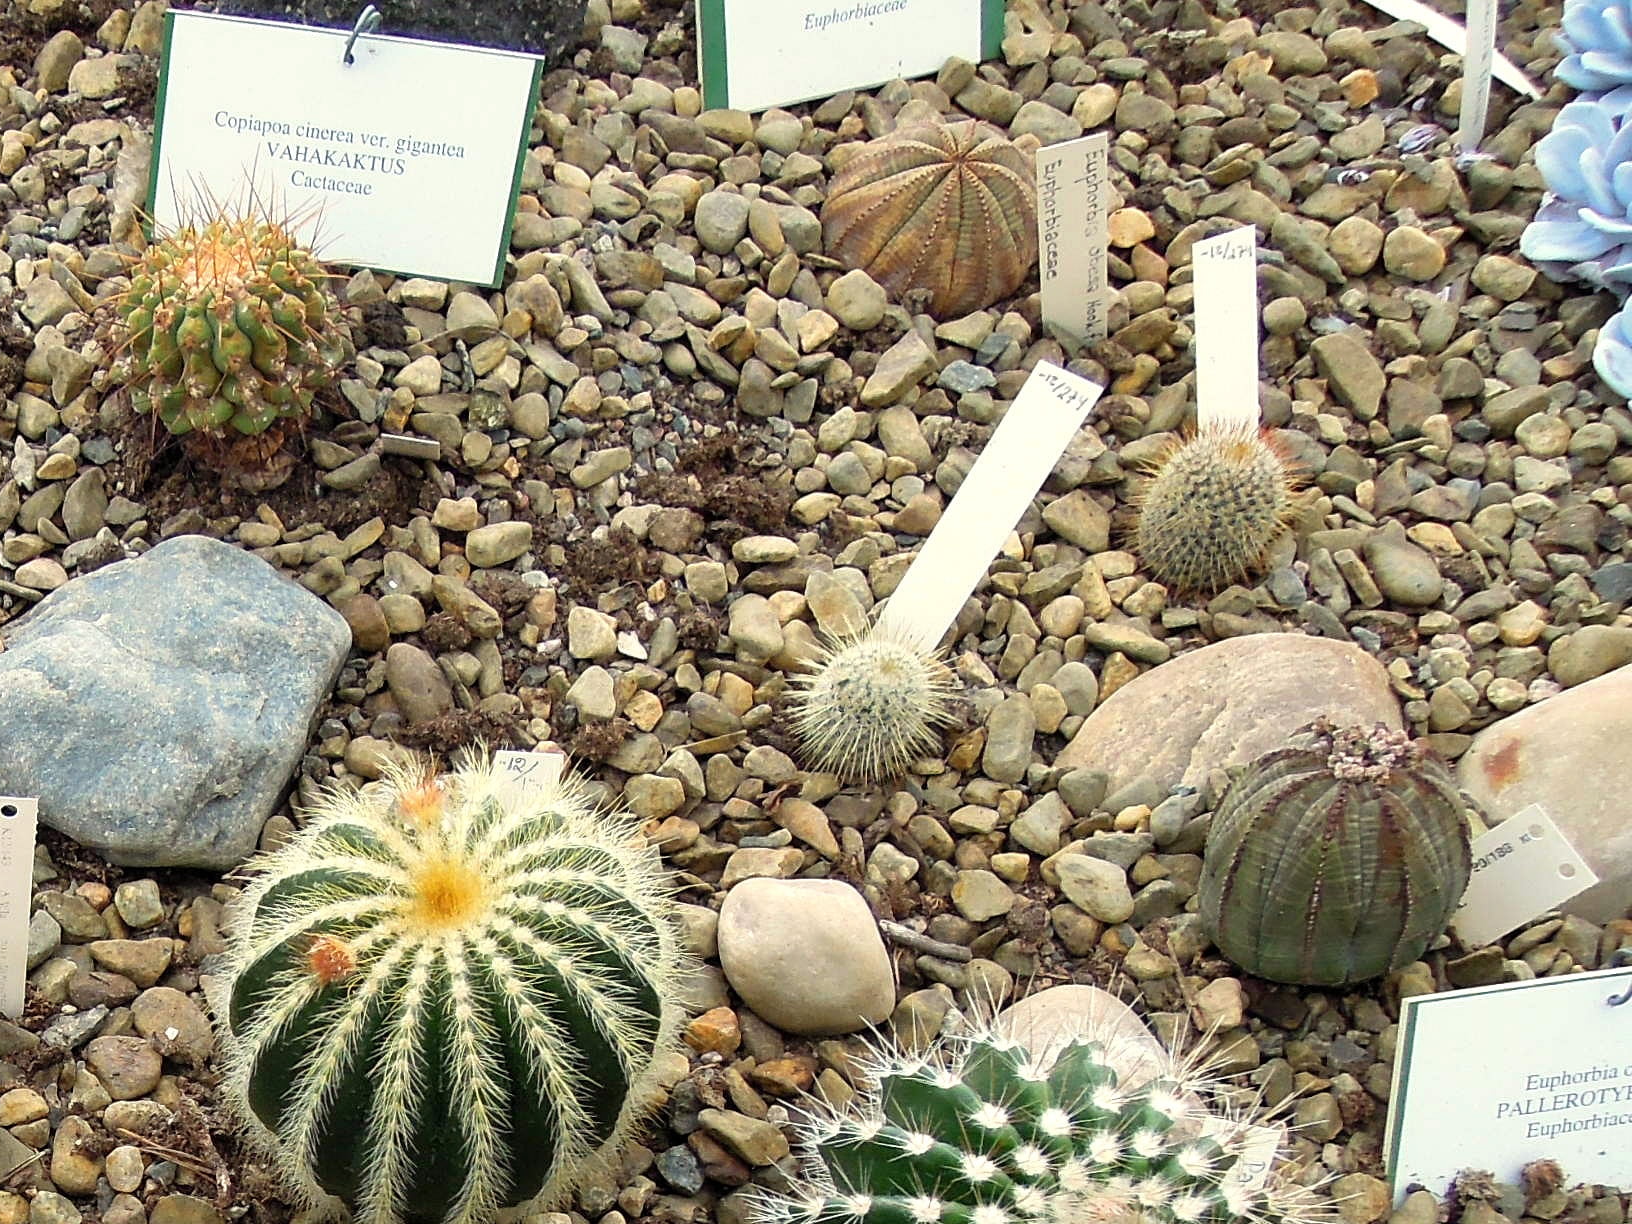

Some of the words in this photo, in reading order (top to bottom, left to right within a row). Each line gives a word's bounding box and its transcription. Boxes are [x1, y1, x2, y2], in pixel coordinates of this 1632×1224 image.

[804, 0, 908, 30] Euphorbiaceae
[214, 110, 291, 137] Copiapoa
[296, 122, 354, 144] cinerea
[360, 132, 390, 150] ver.
[396, 135, 466, 159] gigantea
[267, 141, 407, 176] VAHAKAKTUS
[291, 170, 373, 196] Cactaceae
[1526, 1065, 1618, 1091] Euphorbia
